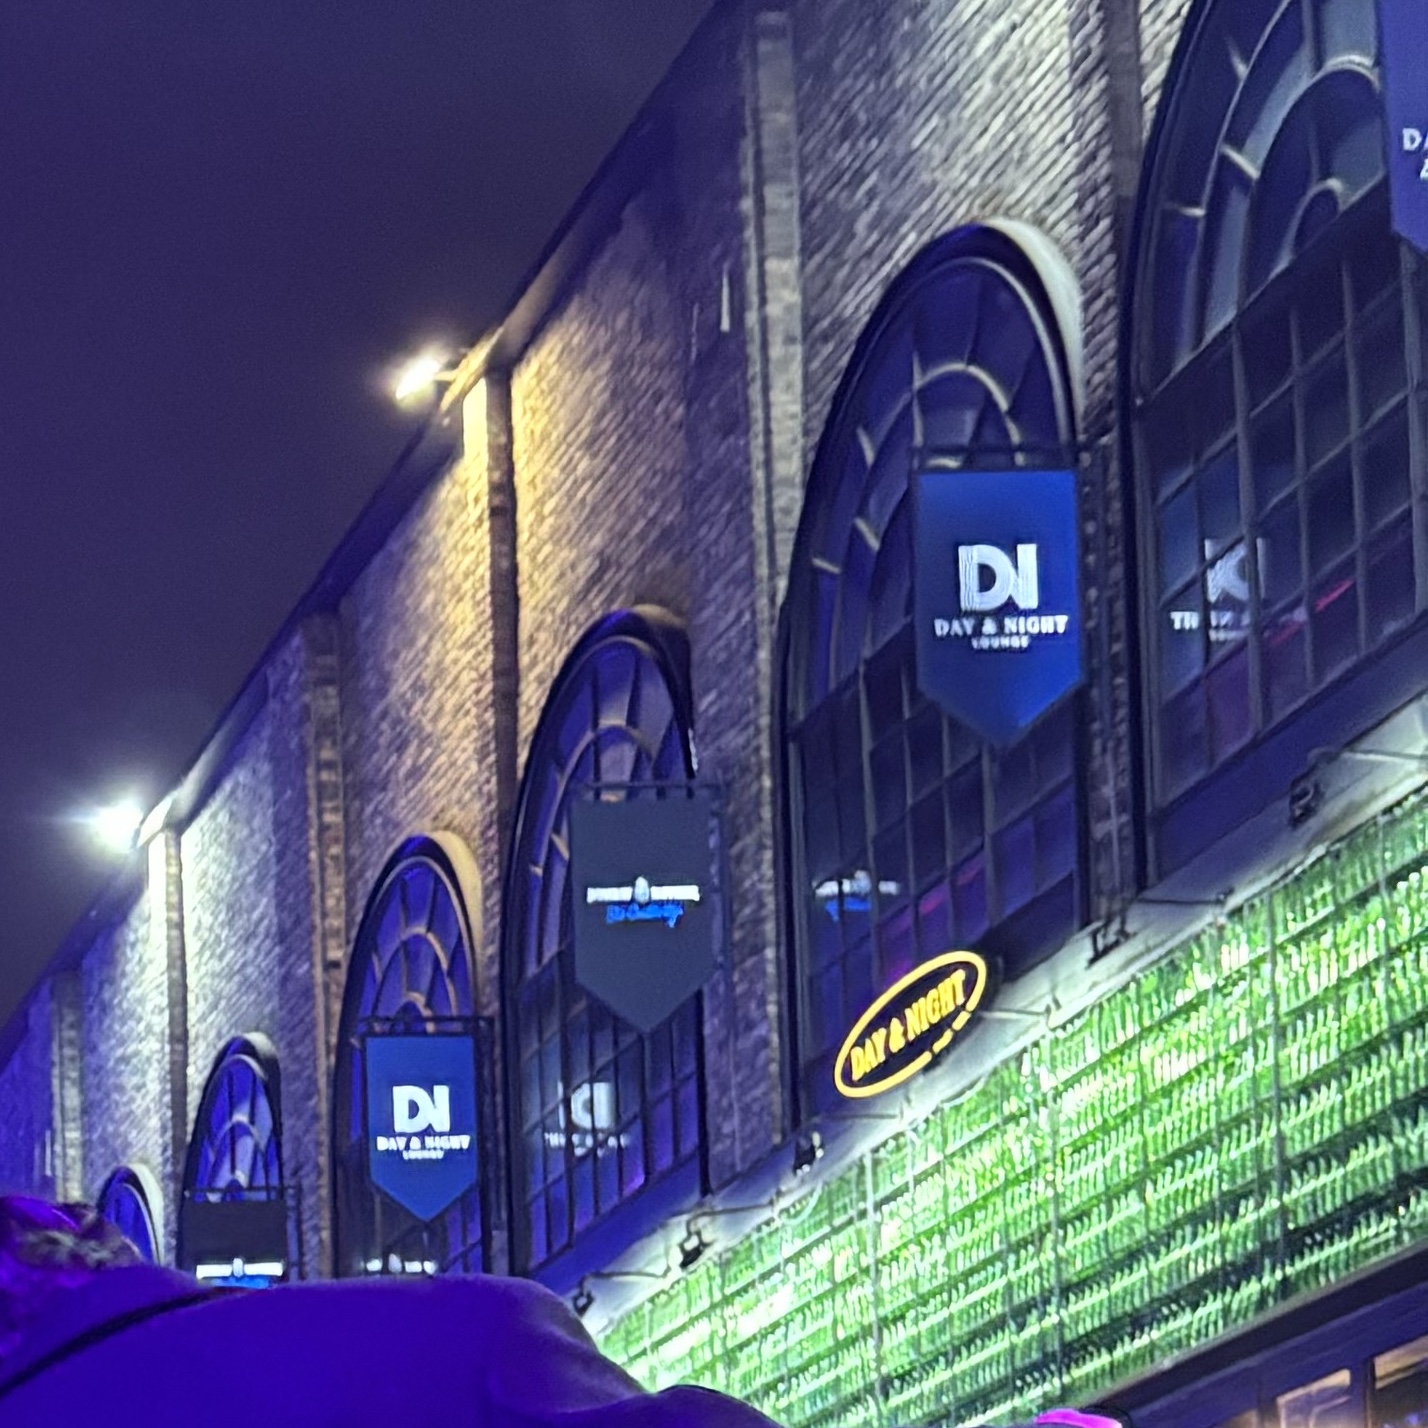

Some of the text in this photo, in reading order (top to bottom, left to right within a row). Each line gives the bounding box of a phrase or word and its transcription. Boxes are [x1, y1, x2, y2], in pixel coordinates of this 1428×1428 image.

[934, 618, 975, 637] DAY
[1004, 614, 1069, 635] NIGHT
[850, 968, 966, 1082] DAY & NIGHT
